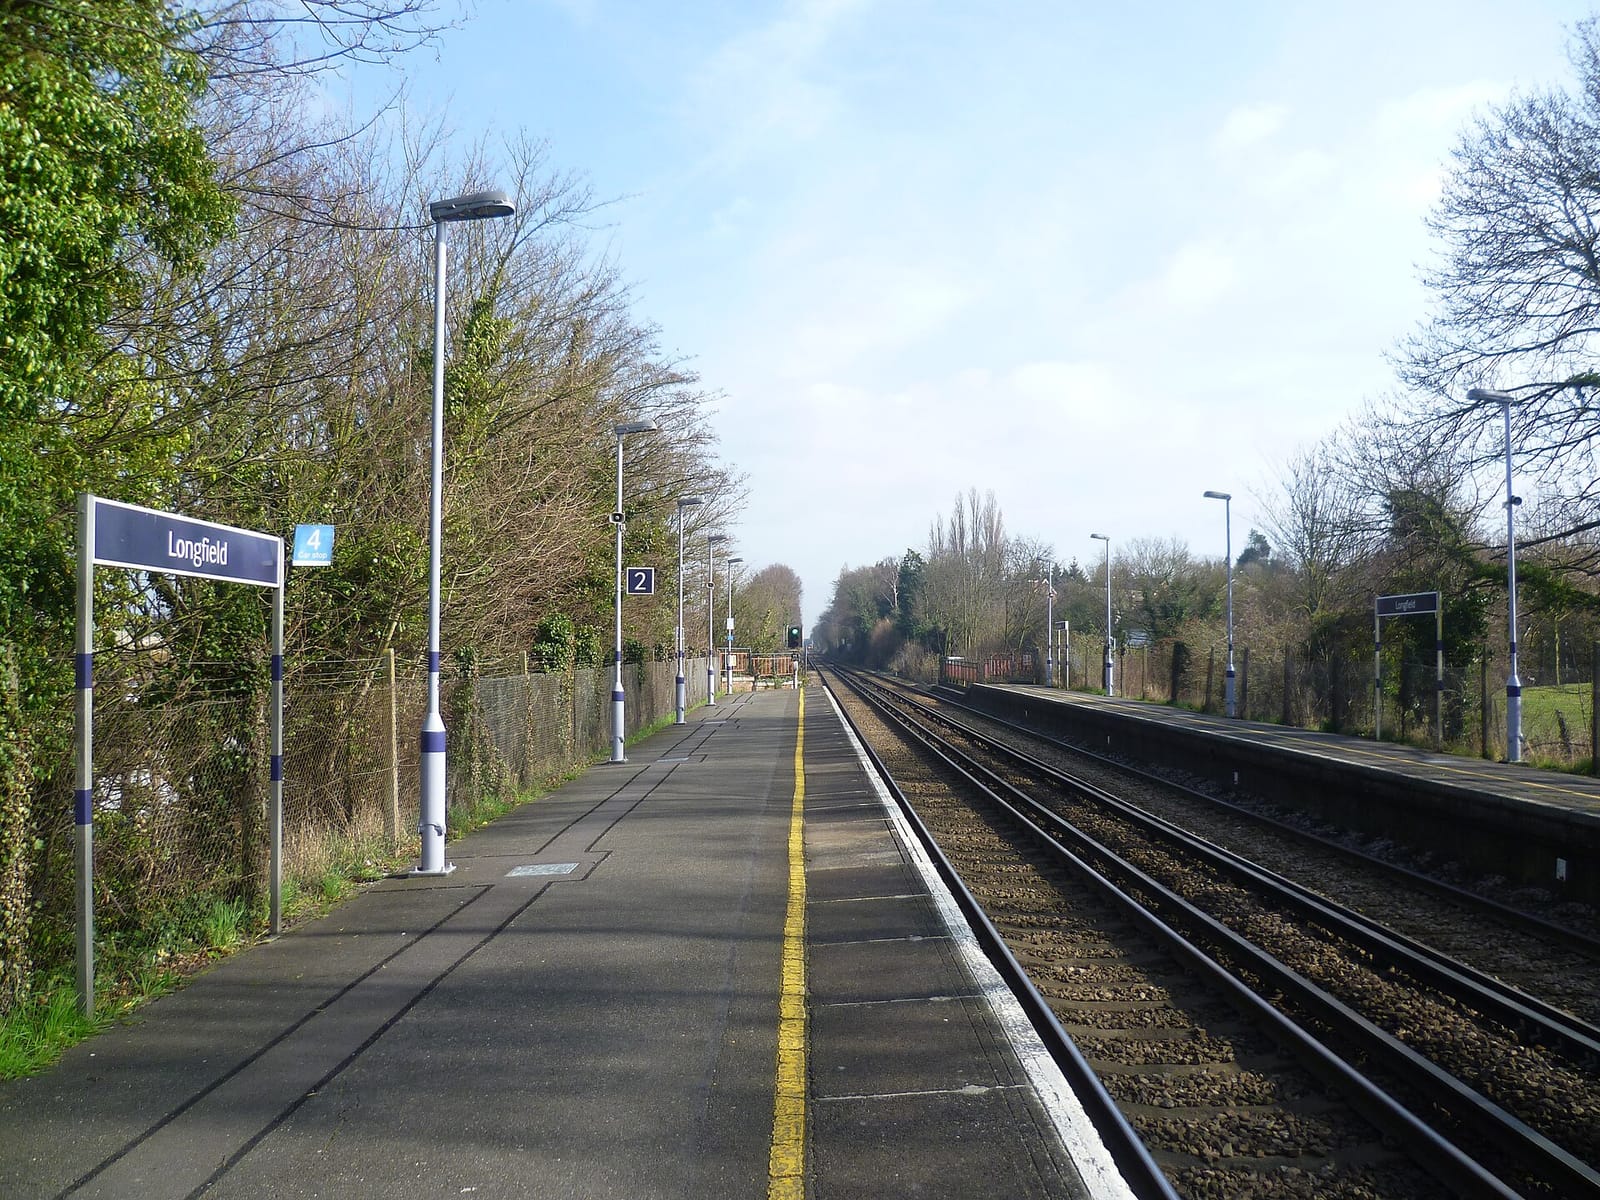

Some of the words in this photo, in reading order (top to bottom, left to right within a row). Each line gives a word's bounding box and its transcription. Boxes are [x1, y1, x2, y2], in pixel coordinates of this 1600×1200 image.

[168, 530, 228, 567] Longfield
[307, 529, 321, 550] 4
[634, 571, 646, 591] 2
[1395, 600, 1416, 611] Longfield
